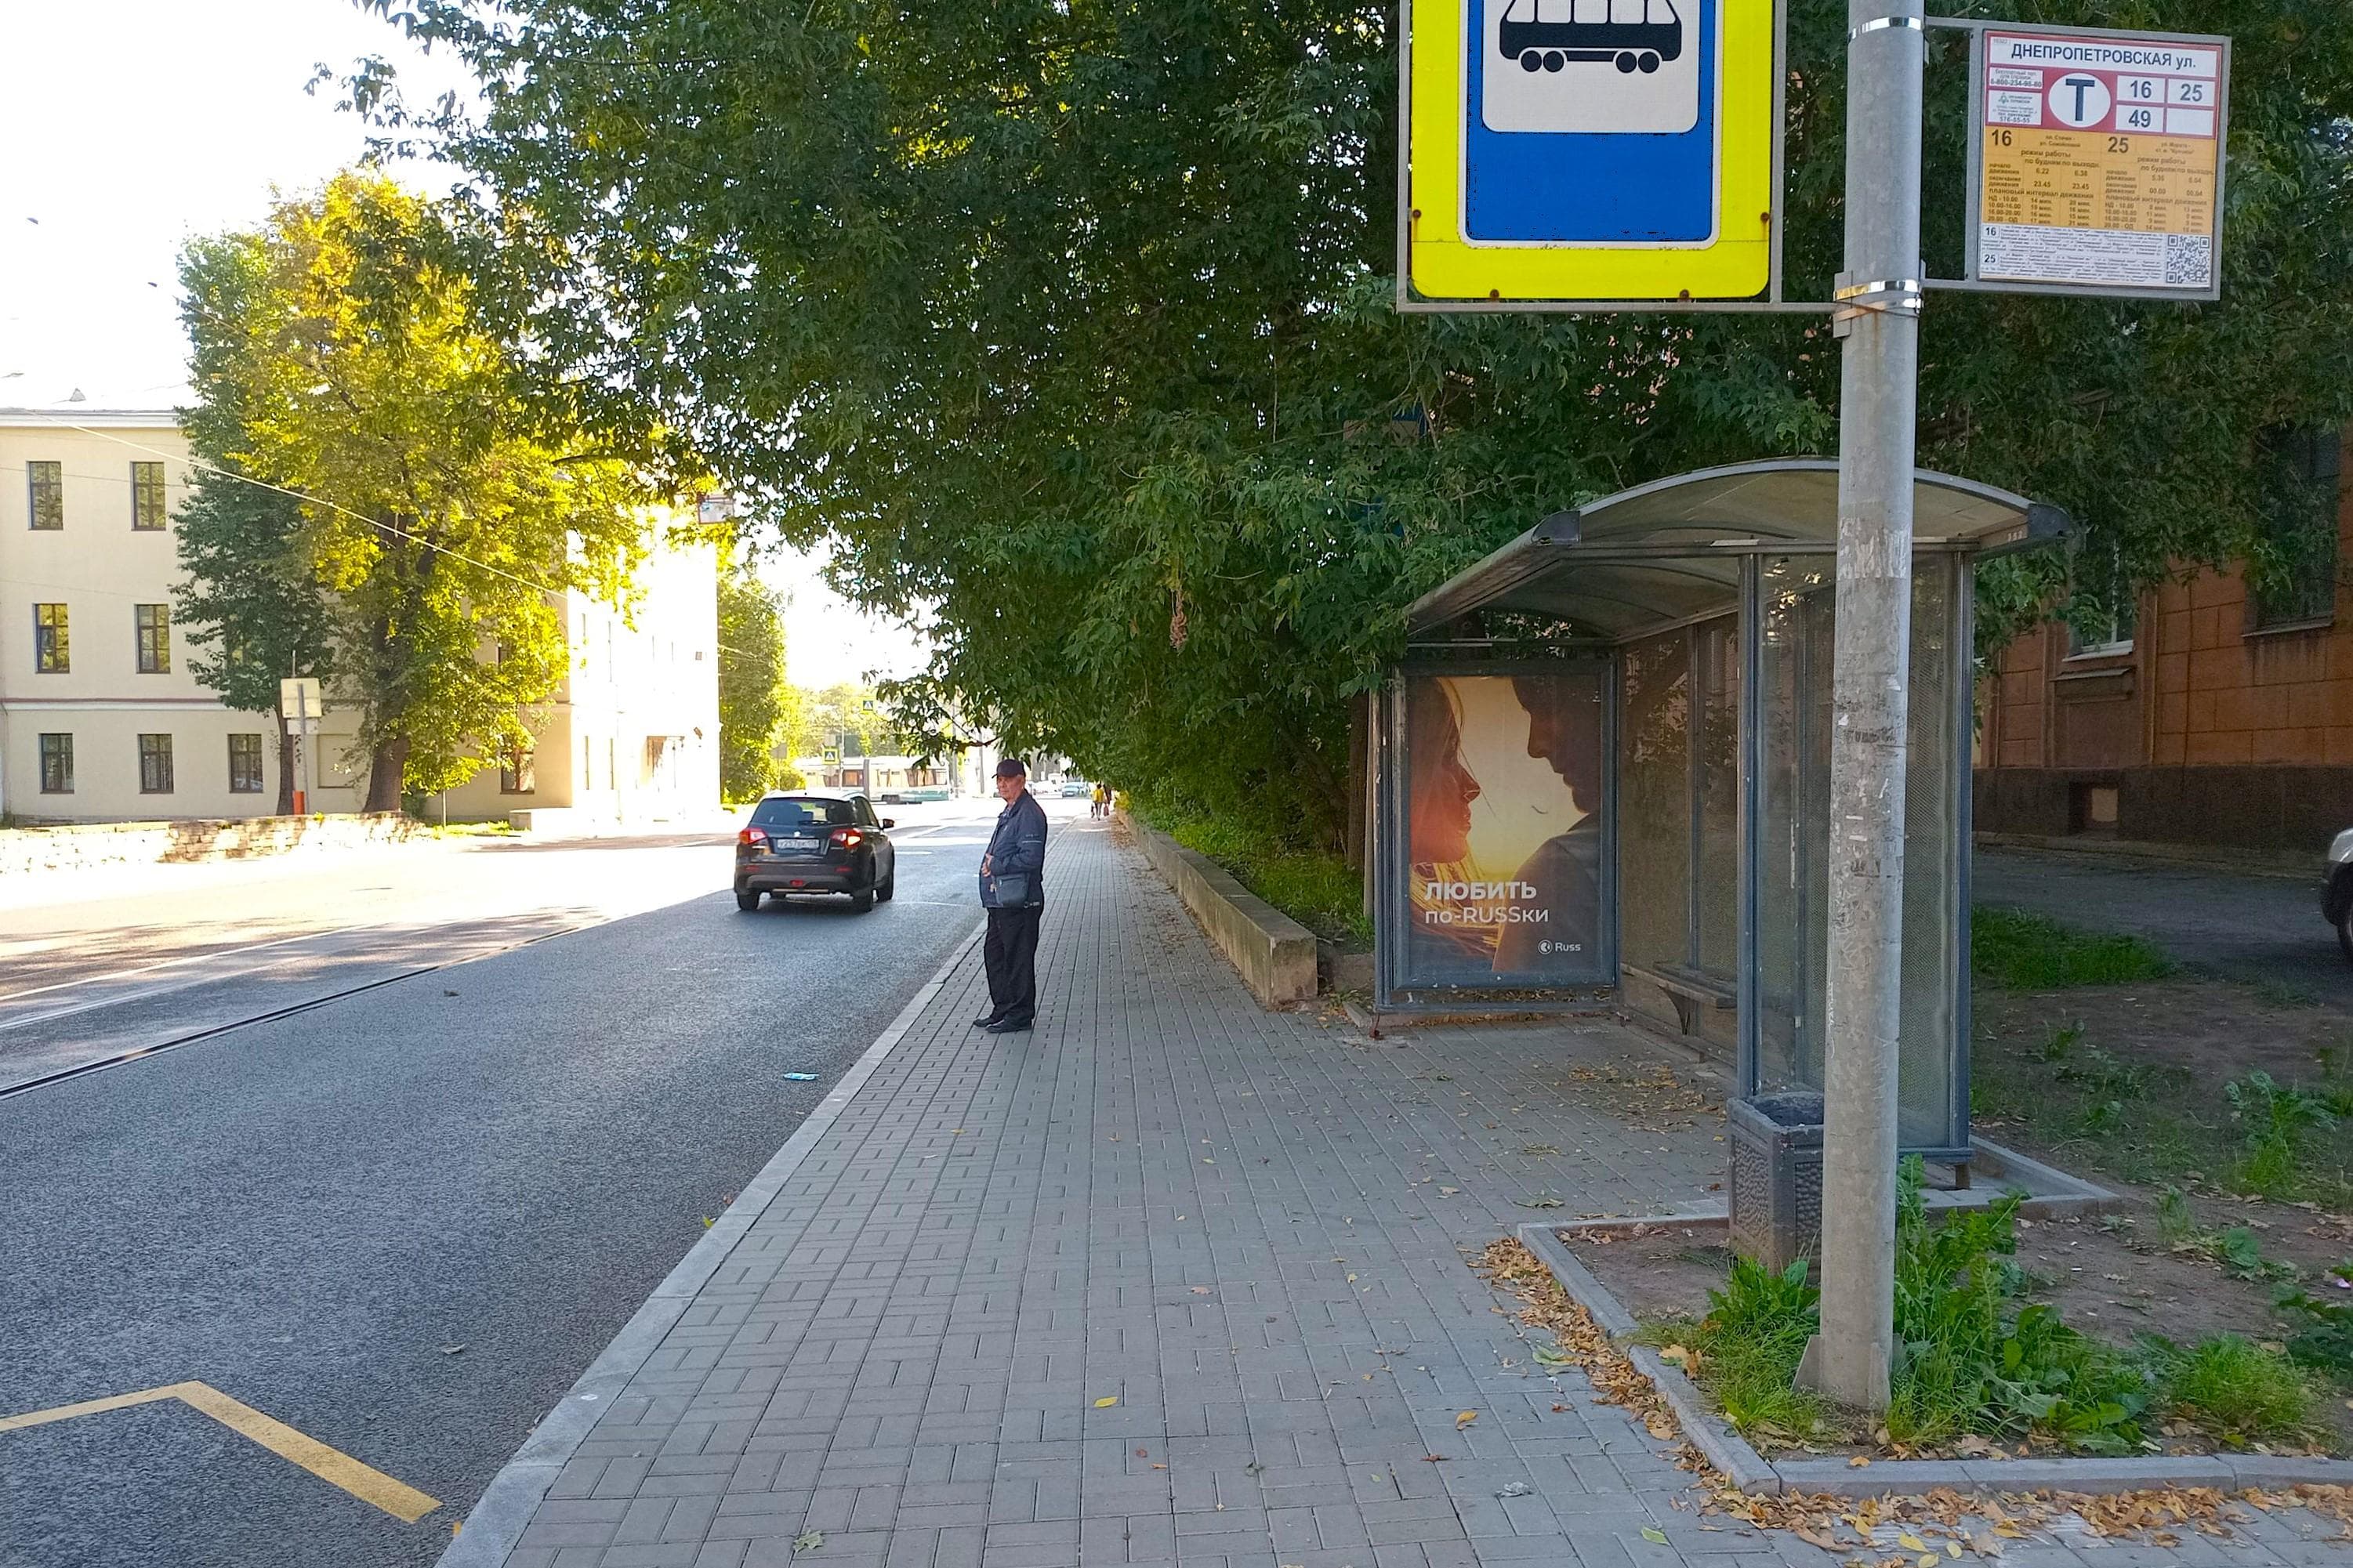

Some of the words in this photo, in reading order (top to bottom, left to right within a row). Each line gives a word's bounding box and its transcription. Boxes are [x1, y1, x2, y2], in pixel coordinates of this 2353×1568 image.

[2011, 43, 2171, 66] ДНЕПРОПЕТРОВСКАЯ
[2176, 56, 2196, 70] ул.
[2130, 80, 2152, 98] 16
[2181, 84, 2203, 101] 25
[2129, 110, 2151, 128] 49
[1992, 129, 2012, 147] 16
[2108, 136, 2129, 154] 25
[1986, 227, 1996, 236] 16
[1984, 254, 1996, 263] 25
[1425, 882, 1536, 900] ЛЮБИТЬ
[1425, 906, 1548, 923] по-RUSSки
[1555, 942, 1581, 951] Russ
